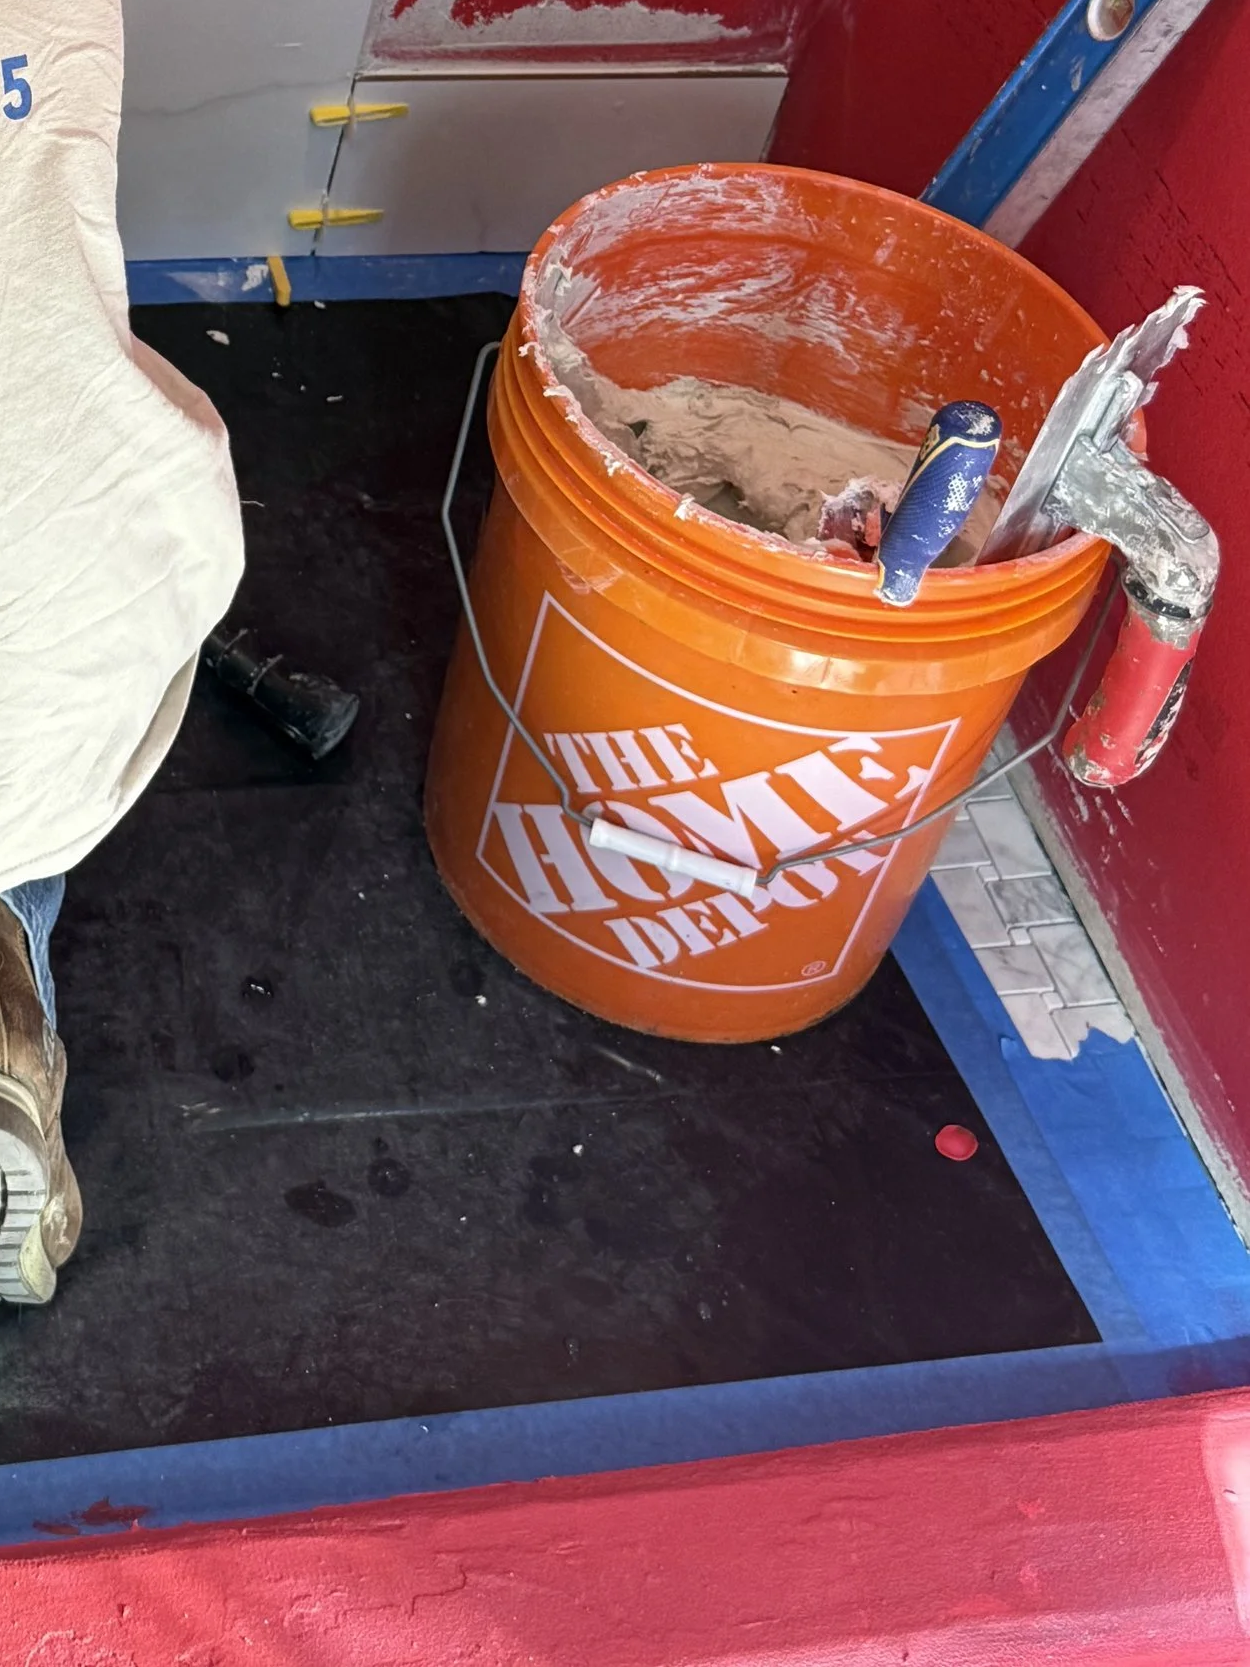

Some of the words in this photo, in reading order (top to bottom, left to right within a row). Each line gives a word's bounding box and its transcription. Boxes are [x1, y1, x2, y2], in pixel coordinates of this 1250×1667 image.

[491, 735, 929, 914] HOME
[543, 723, 720, 795] THE
[603, 829, 888, 970] DEPOT
